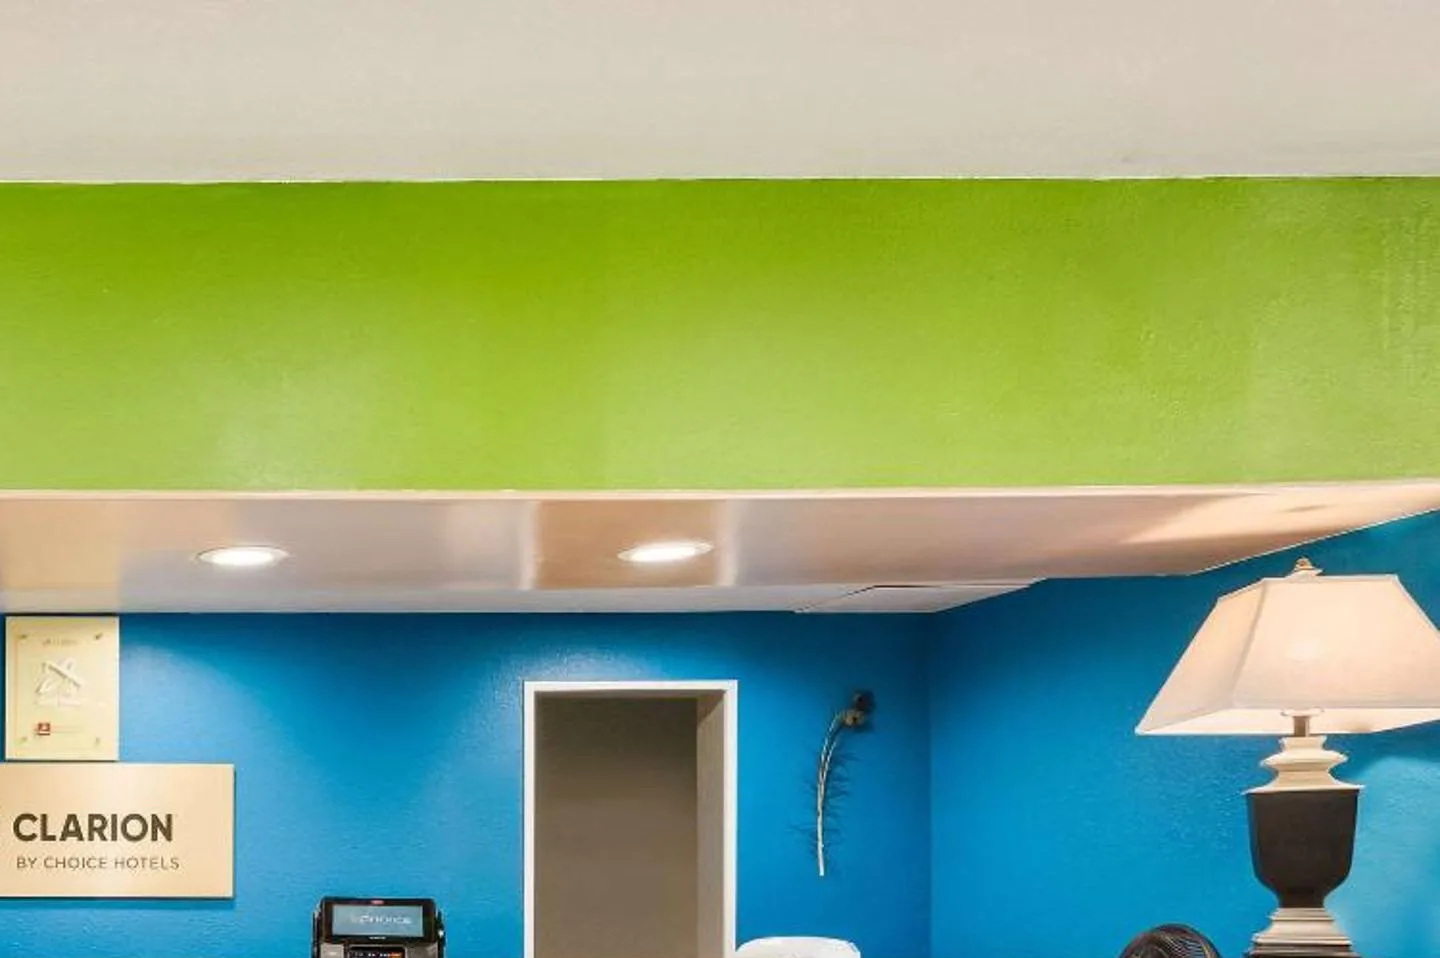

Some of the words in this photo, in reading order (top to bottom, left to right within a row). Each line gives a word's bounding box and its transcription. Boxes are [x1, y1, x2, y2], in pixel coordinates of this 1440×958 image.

[13, 813, 173, 842] CLARION
[16, 856, 38, 869] BY
[43, 856, 107, 869] CHOICE
[114, 856, 179, 869] HOTELS
